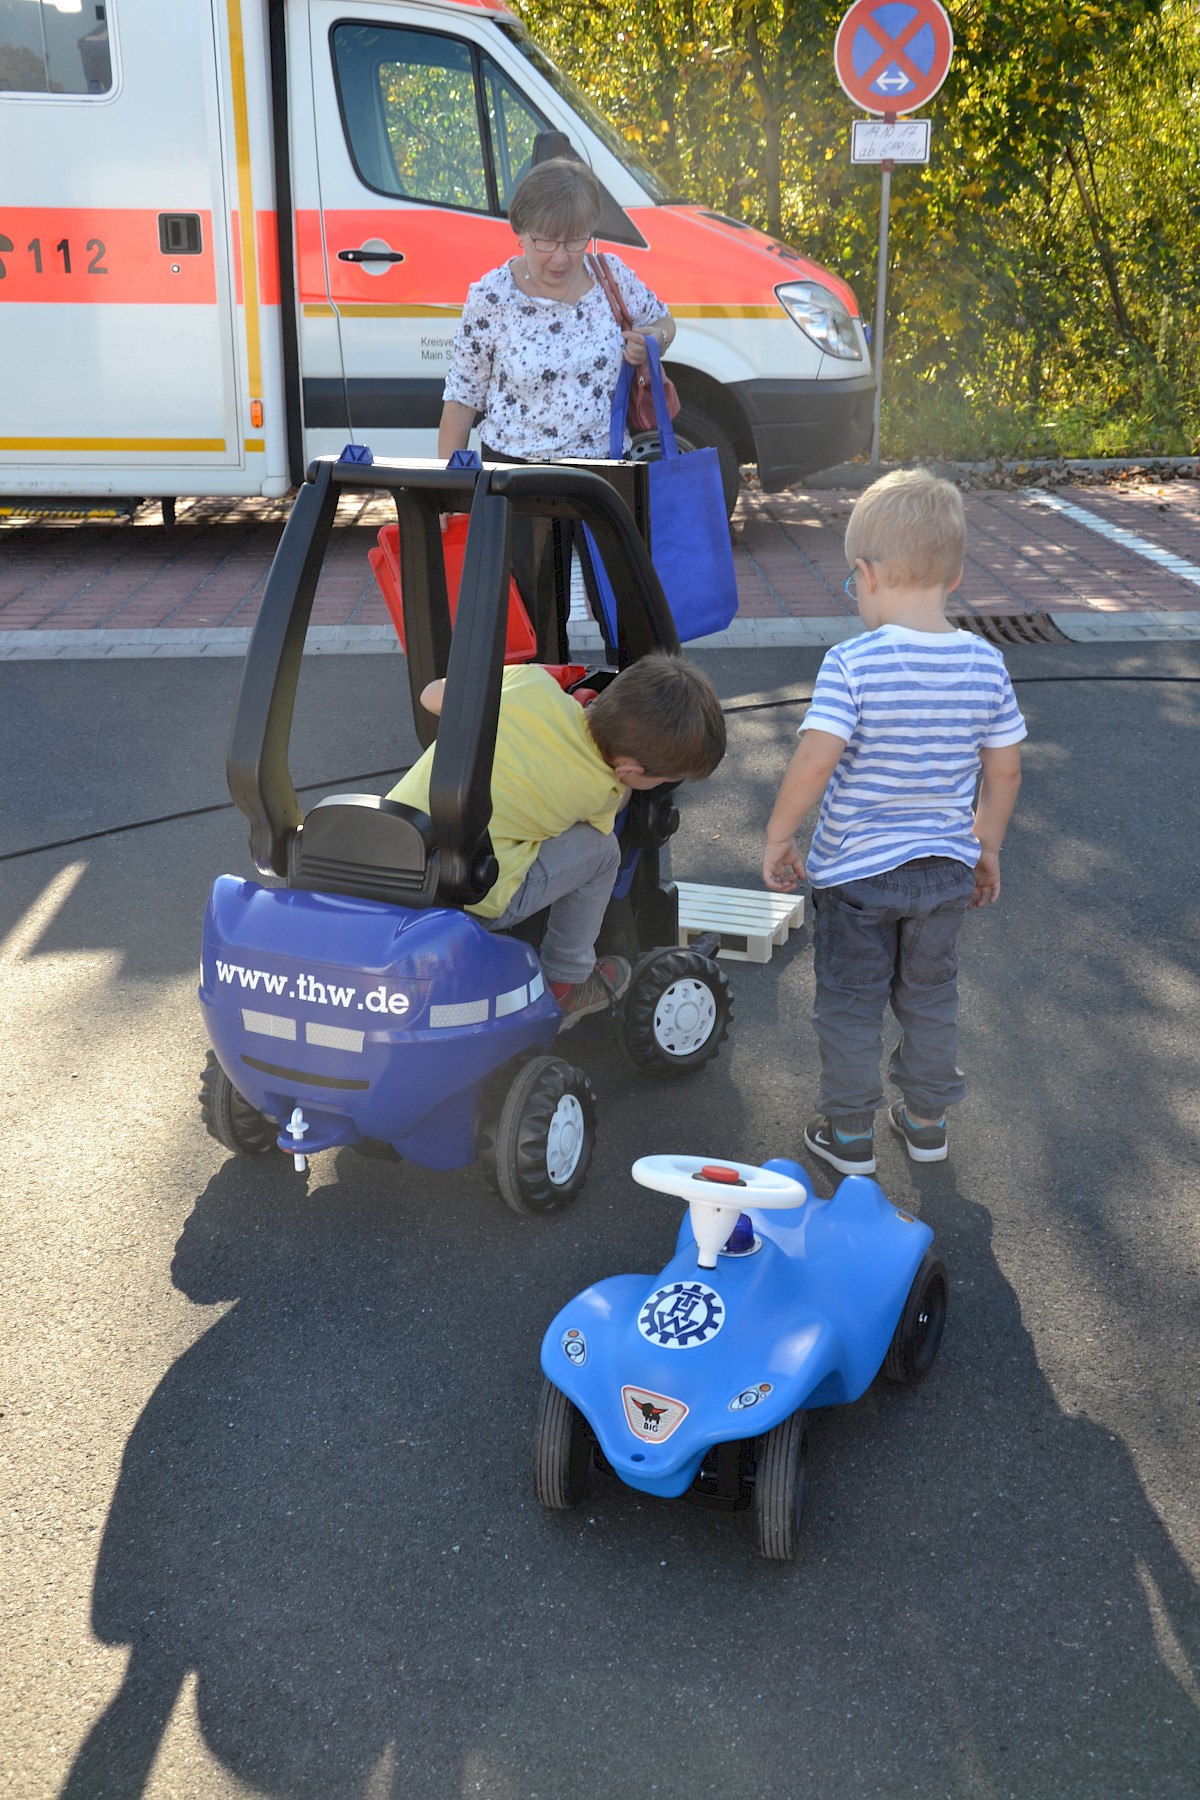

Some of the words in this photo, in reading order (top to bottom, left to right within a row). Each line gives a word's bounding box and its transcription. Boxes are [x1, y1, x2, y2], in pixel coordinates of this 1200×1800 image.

[859, 141, 875, 157] ab
[900, 141, 925, 157] Uhr
[27, 238, 108, 274] 112
[420, 336, 454, 347] Kreisve
[421, 350, 443, 360] Main
[445, 350, 454, 361] S
[215, 960, 410, 1015] www.thw.de
[643, 1422, 659, 1433] BIG
